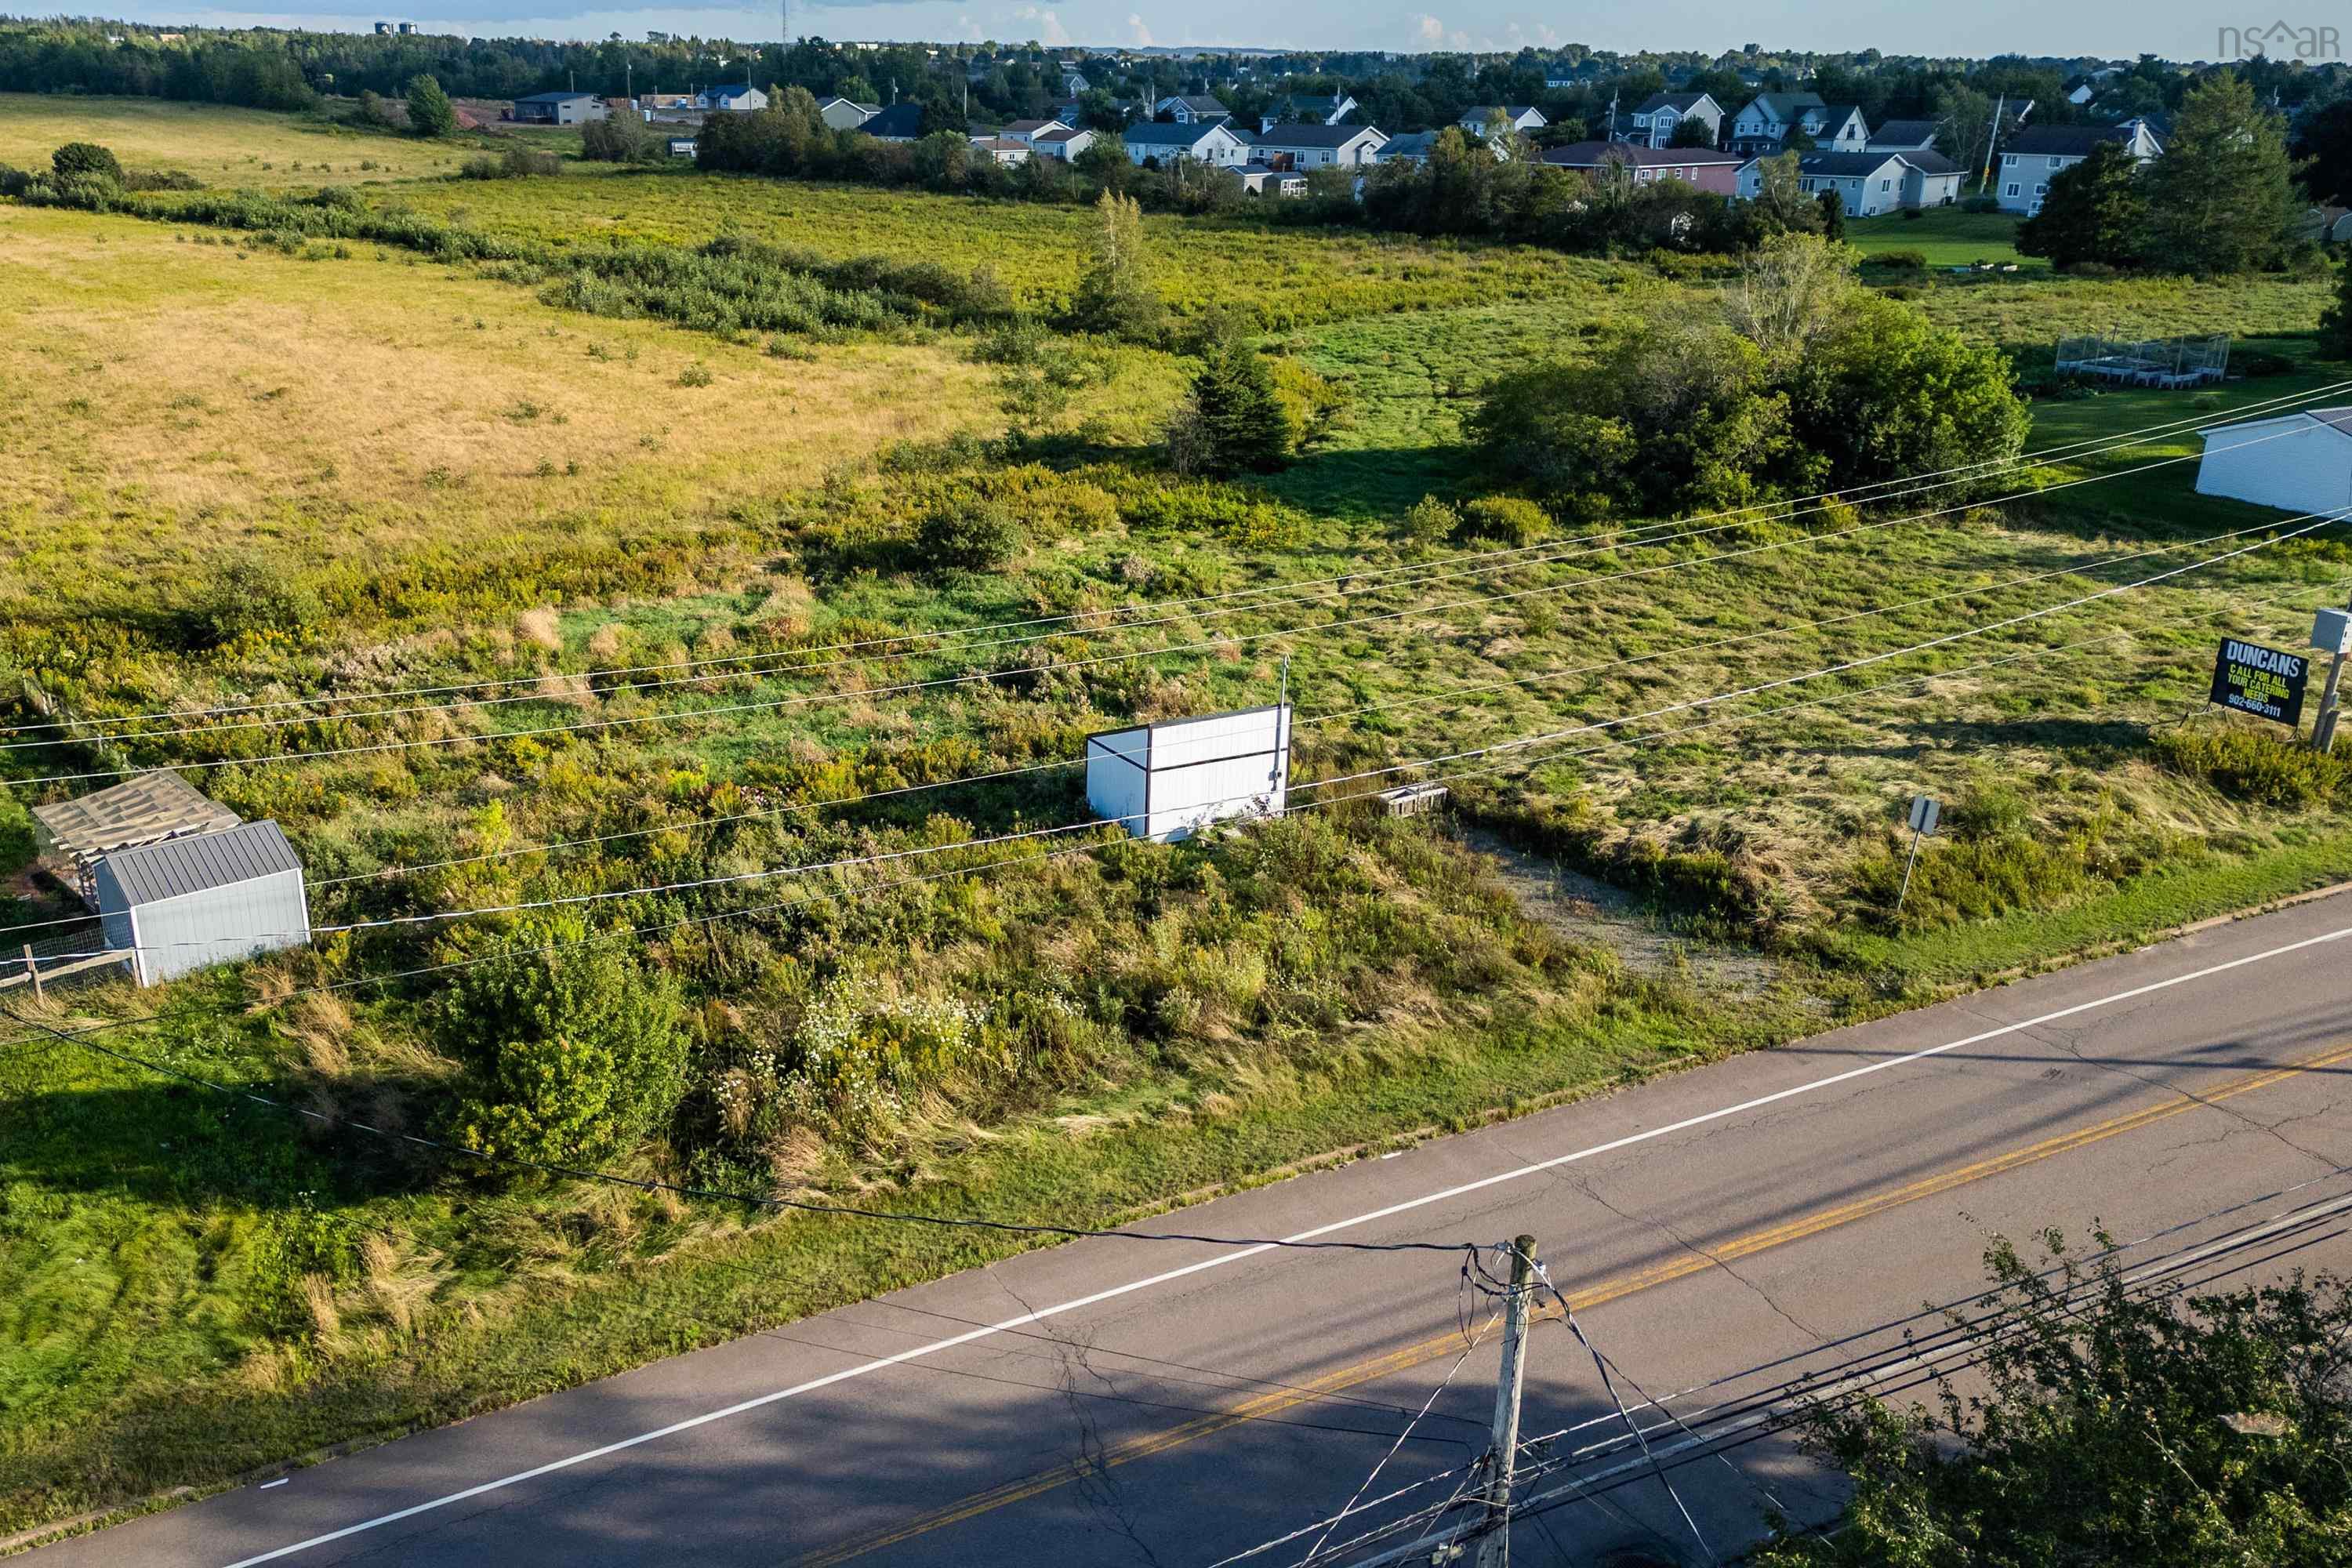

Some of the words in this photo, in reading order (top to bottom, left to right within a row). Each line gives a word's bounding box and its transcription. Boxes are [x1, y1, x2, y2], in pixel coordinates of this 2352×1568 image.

[2227, 641, 2300, 677] DUNCANS
[2227, 673, 2249, 687] YOUR
[2249, 680, 2289, 699] CATERING
[2230, 664, 2252, 679] CALL
[2254, 670, 2270, 684] FOR
[2271, 675, 2287, 688] ALL
[2244, 688, 2270, 703] NEEDS
